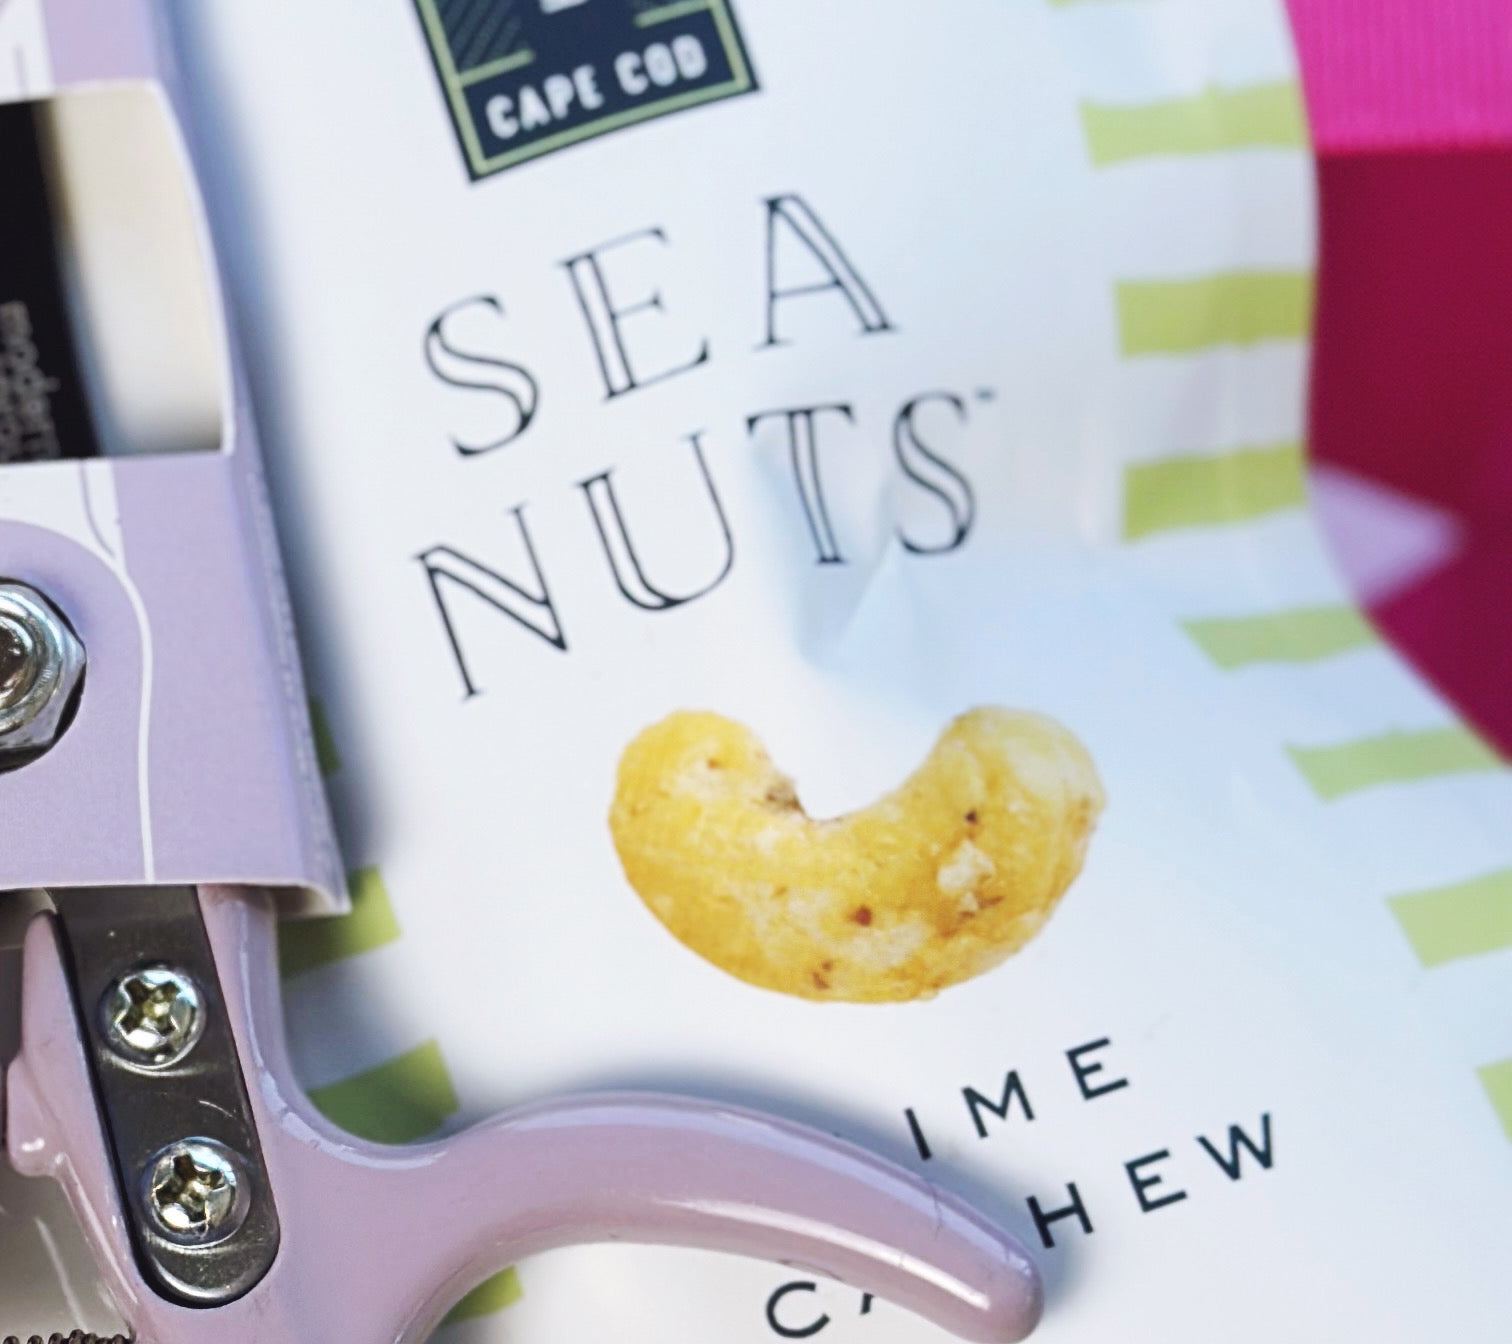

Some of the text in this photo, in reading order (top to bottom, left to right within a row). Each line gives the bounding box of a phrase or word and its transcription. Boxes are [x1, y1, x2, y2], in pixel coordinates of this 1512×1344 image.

[484, 33, 708, 140] CAPE COD
[422, 192, 901, 458] SEA
[412, 389, 978, 700] NUTS
[903, 1037, 1129, 1161] IME
[765, 1113, 1276, 1339] CHEW
